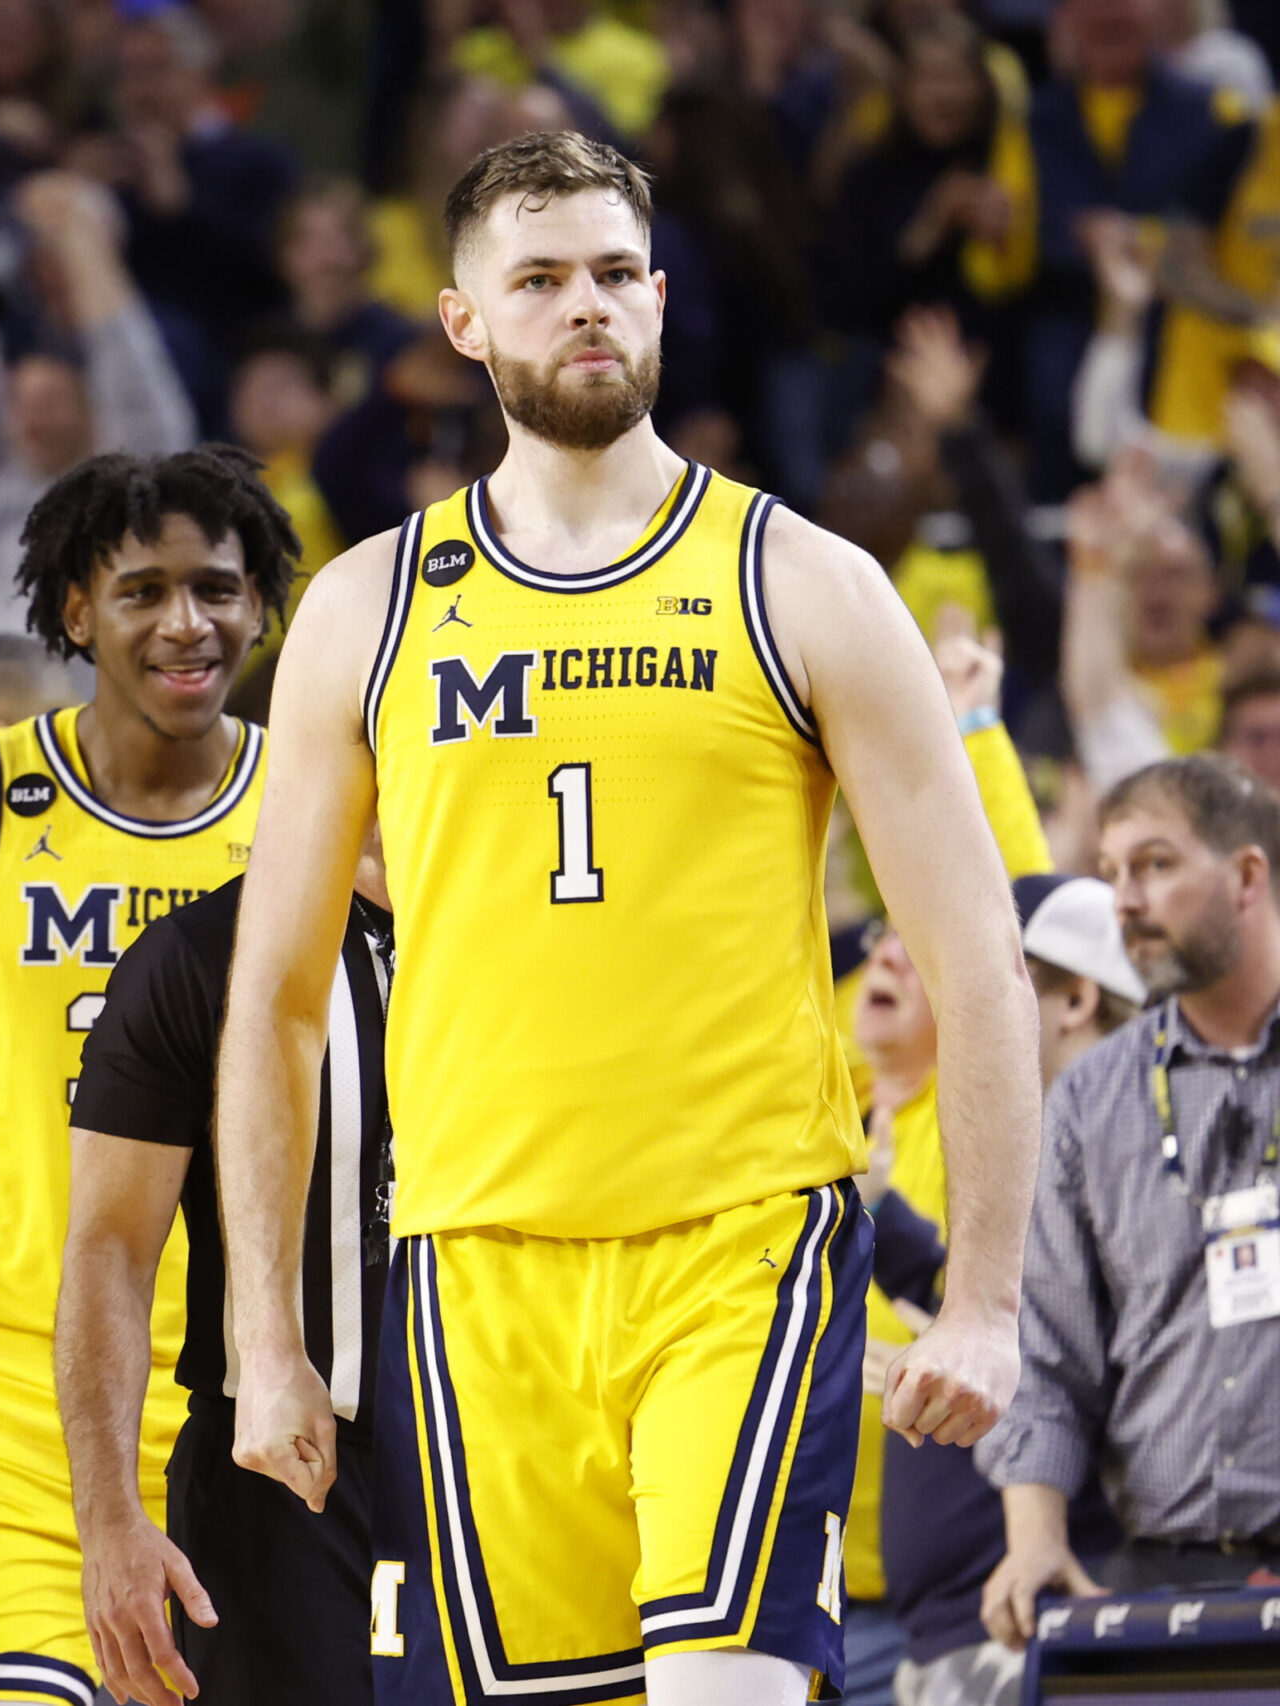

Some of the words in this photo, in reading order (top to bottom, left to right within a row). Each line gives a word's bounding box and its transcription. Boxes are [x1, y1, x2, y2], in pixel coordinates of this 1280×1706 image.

[426, 552, 468, 574] BLM
[428, 646, 718, 747] MICHIGAN
[10, 786, 50, 803] BLM
[547, 762, 605, 905] 1
